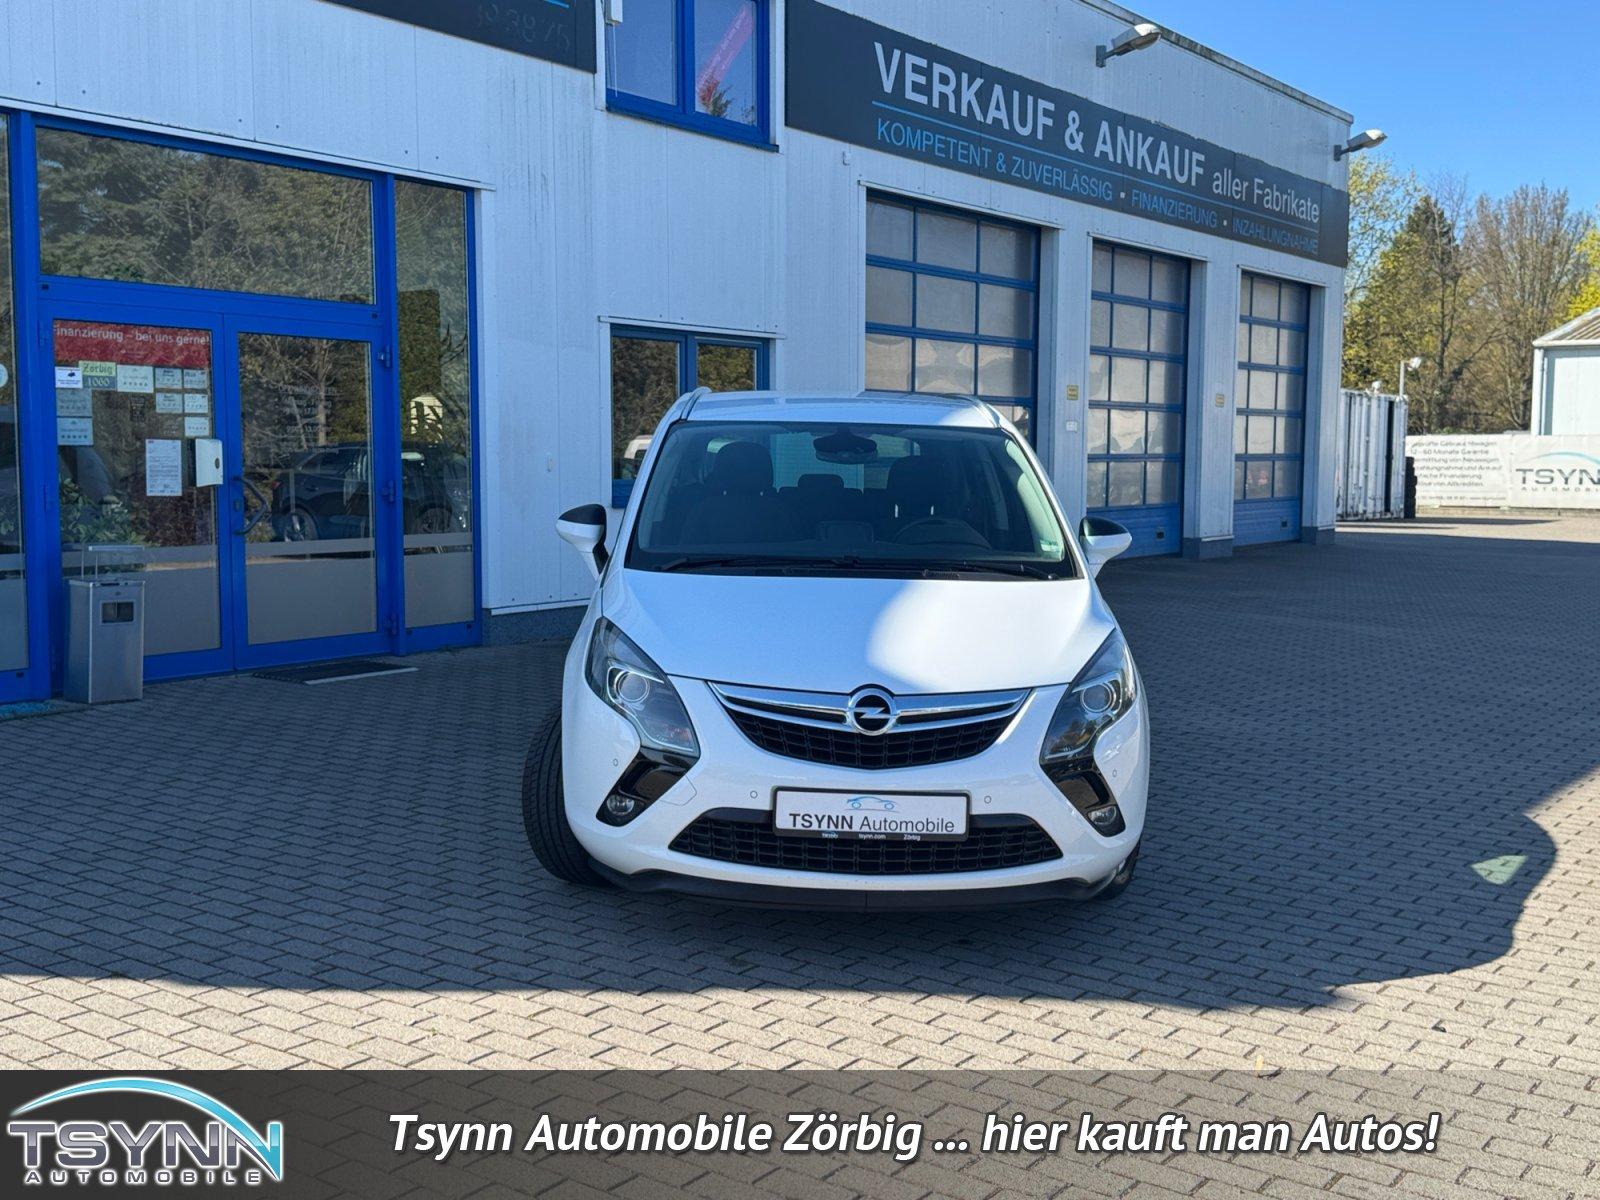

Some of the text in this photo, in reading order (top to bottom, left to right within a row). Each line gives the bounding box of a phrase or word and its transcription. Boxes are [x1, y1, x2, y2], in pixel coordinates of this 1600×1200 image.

[874, 41, 1320, 224] VERKAUF & ANKAUF aller Fabrikate
[877, 118, 1319, 255] KOMPETENT & ZUVERLÄSSIG FINANZIERUNG INZAHLUNGNAHME
[155, 334, 174, 344] uns
[789, 813, 955, 833] TSYNN Automobile
